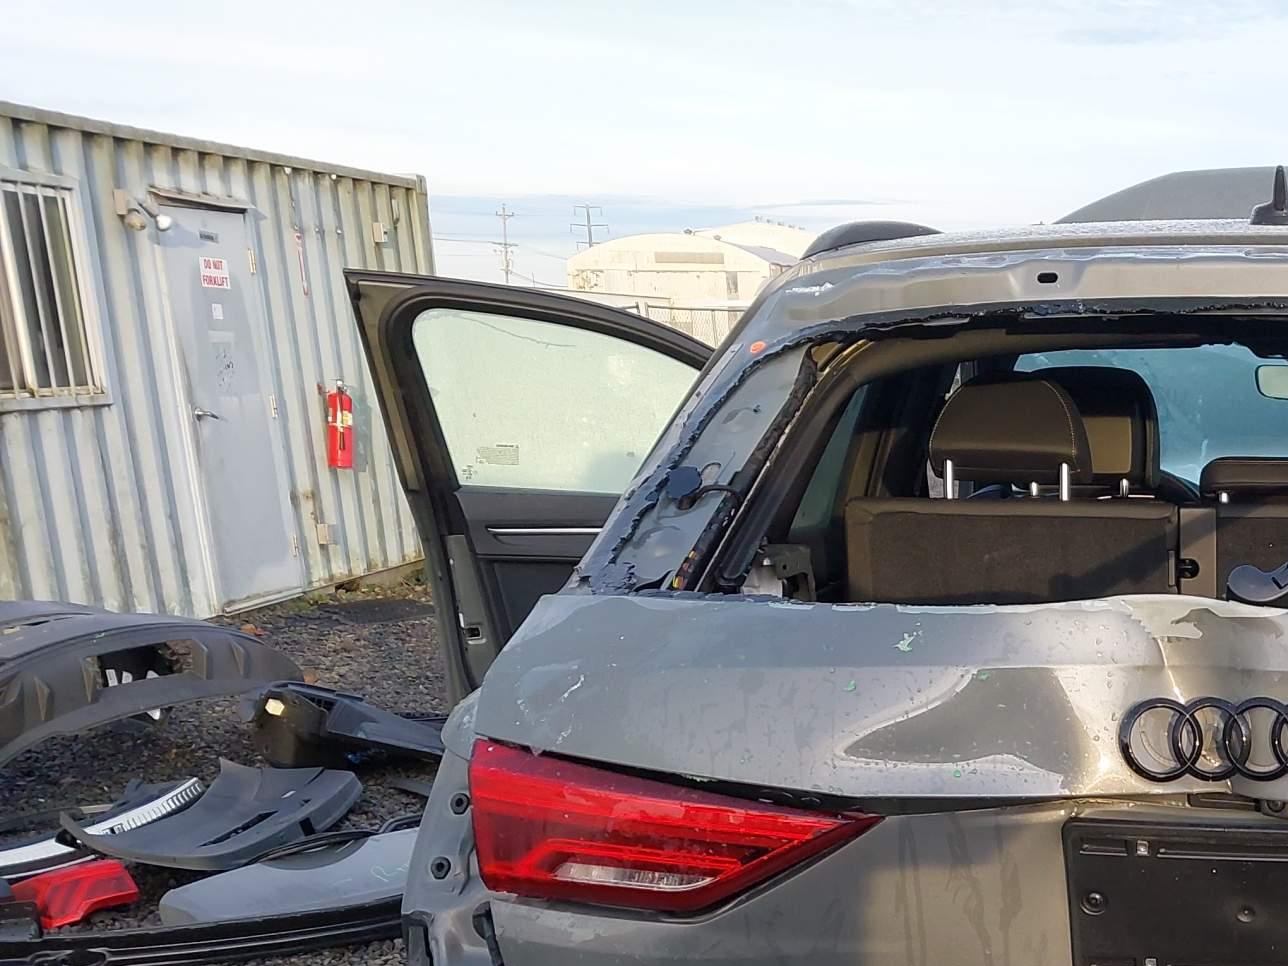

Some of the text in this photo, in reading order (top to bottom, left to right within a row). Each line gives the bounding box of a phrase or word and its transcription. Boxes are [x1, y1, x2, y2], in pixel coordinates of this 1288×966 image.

[203, 259, 223, 270] DO NOT
[202, 274, 229, 288] FORKLIFT
